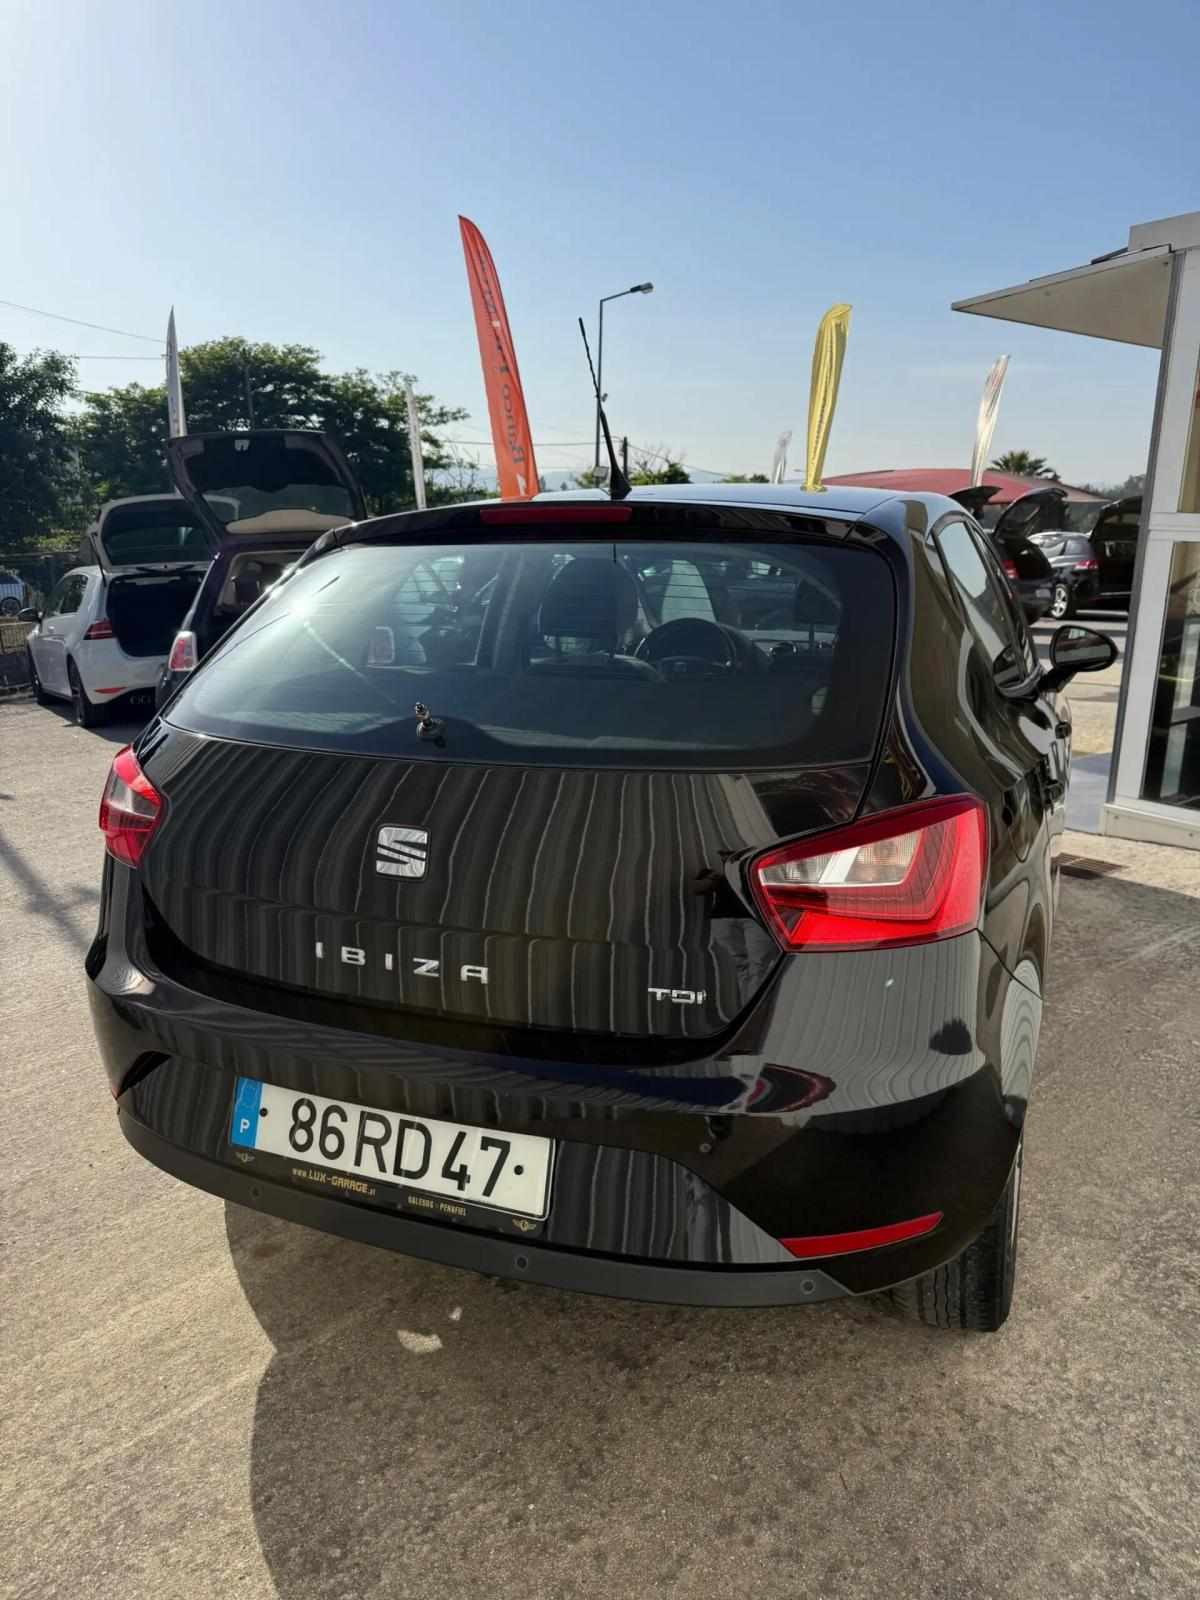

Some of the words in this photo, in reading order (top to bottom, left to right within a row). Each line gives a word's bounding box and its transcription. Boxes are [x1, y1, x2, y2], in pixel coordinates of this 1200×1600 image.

[315, 942, 489, 985] IBIZA
[647, 986, 707, 1006] TDI
[240, 1118, 251, 1133] P
